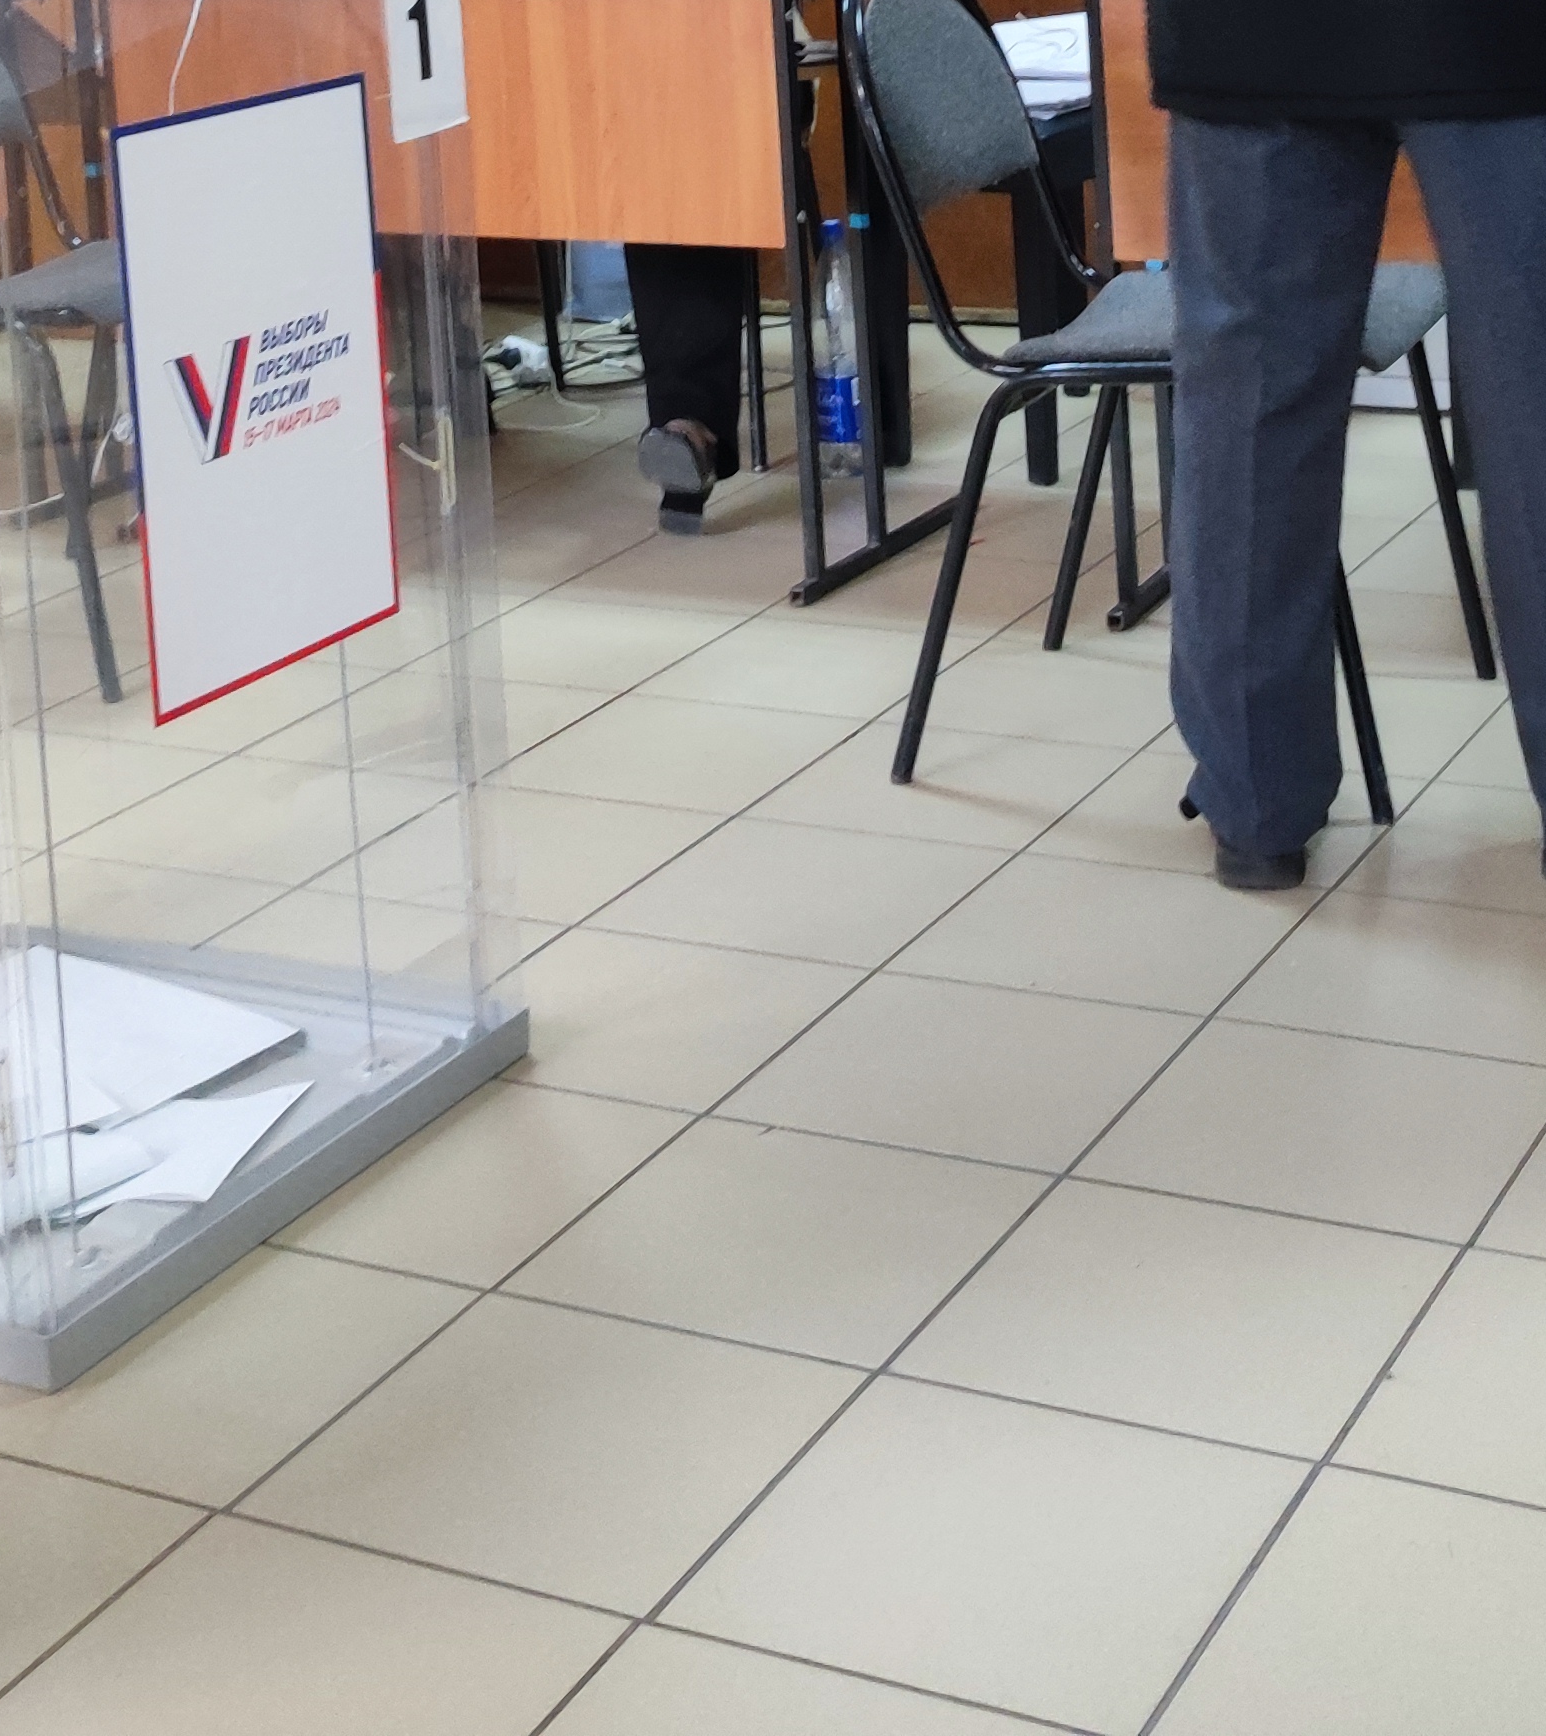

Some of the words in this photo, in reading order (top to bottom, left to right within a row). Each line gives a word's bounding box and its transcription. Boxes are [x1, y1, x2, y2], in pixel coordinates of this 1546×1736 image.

[259, 309, 330, 354] ВЫБОРЫ
[253, 332, 351, 387] ПРЕЗИДЕНТА
[247, 377, 311, 420] РОССИИ
